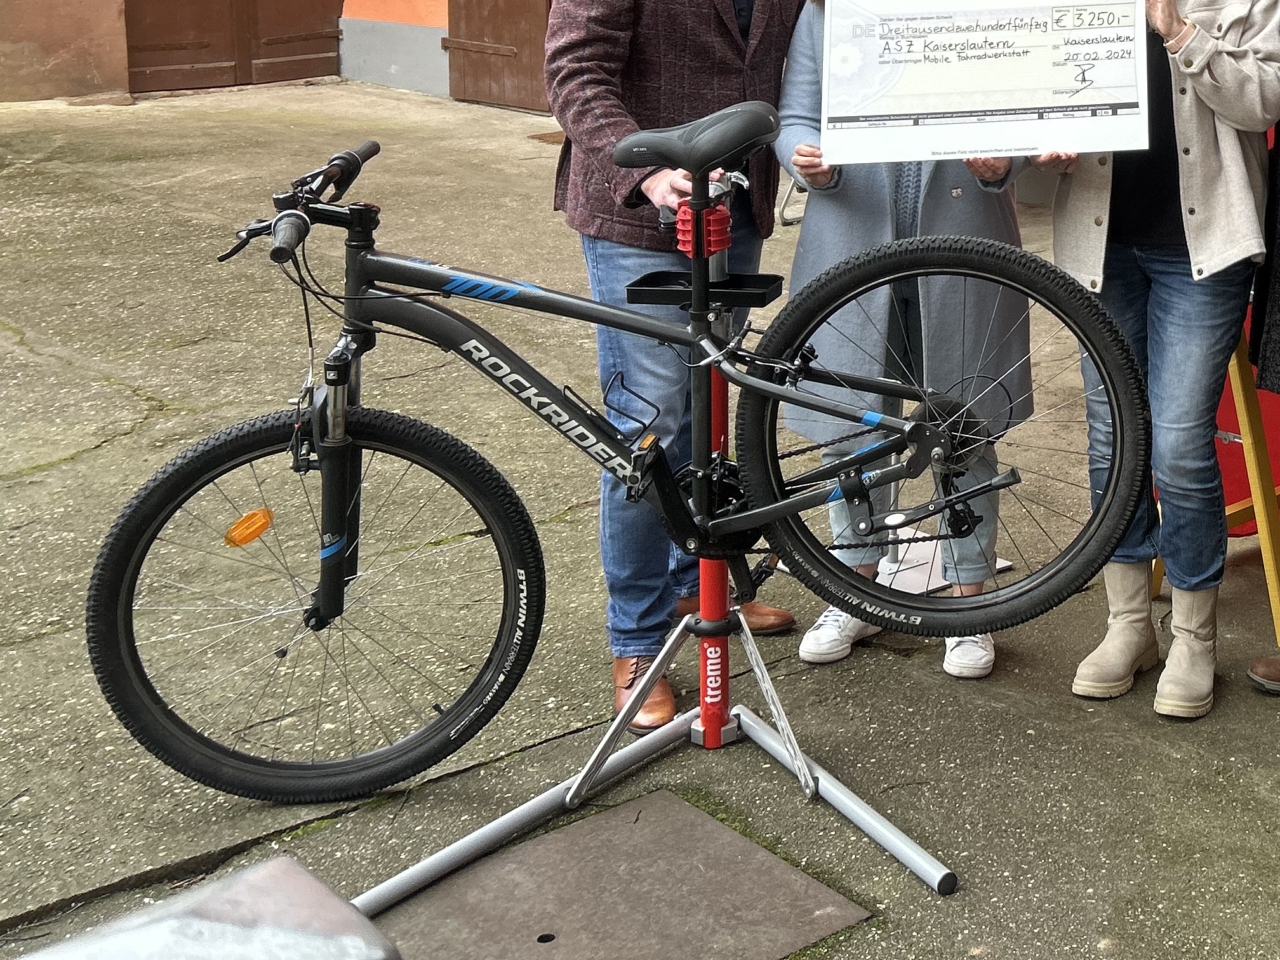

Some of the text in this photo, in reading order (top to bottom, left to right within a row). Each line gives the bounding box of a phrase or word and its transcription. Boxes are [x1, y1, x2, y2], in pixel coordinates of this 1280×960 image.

[1054, 14, 1067, 28] €
[853, 24, 875, 38] DE
[923, 37, 1015, 52] Kaiserslautern
[923, 54, 952, 64] Mobile
[442, 275, 521, 300] 100
[459, 339, 633, 478] ROCKRIDER
